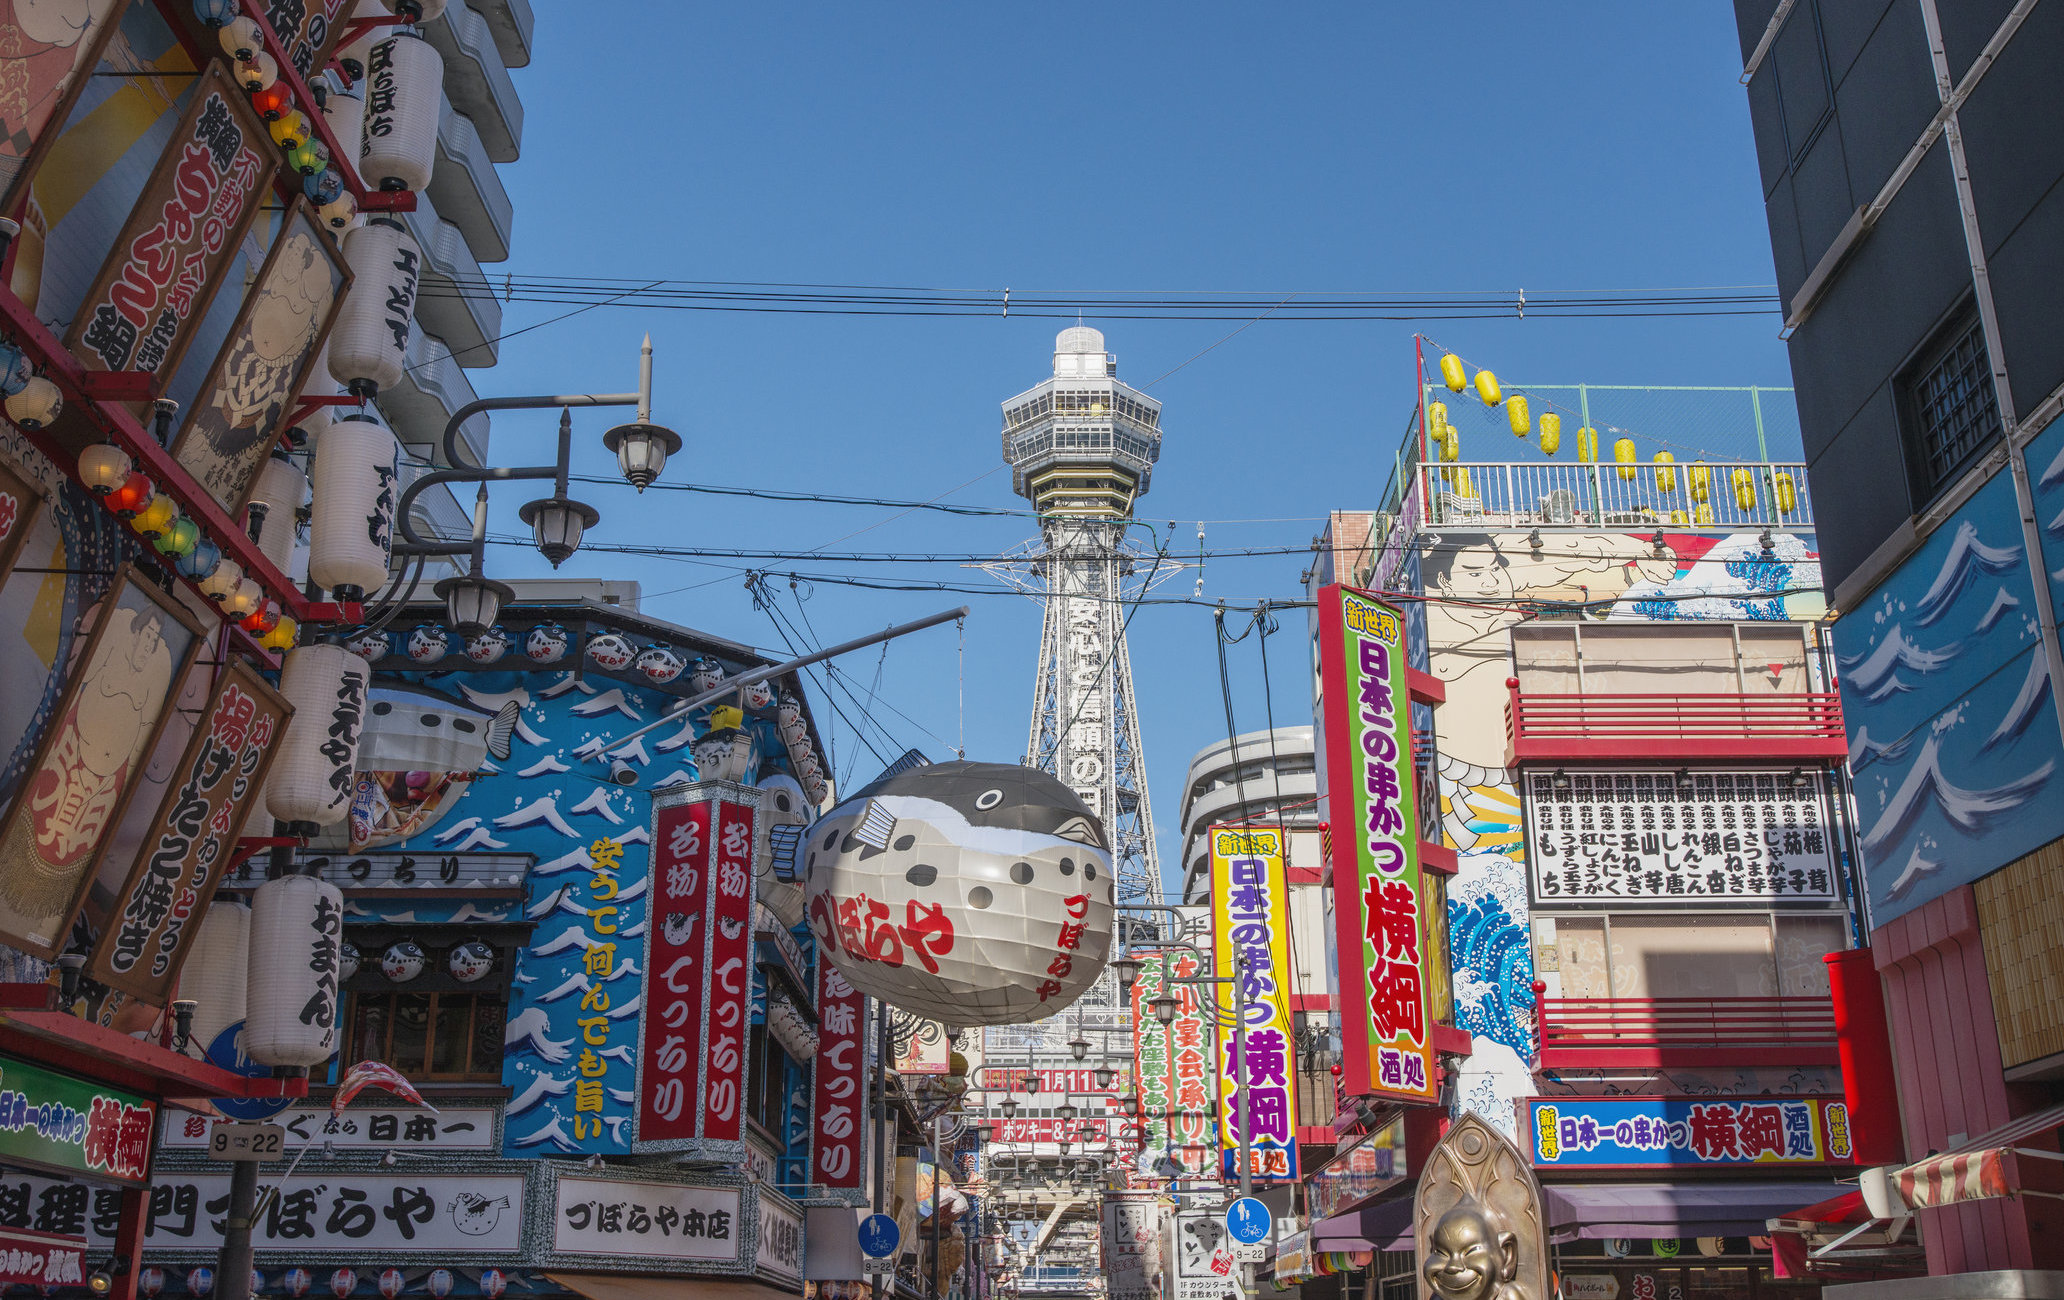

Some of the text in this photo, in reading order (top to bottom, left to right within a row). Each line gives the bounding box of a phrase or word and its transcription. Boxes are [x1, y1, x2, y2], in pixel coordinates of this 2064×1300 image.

[1345, 598, 1397, 645] 新世界
[112, 684, 257, 973] 揚げたこ焼き
[666, 821, 699, 898] 名物
[720, 822, 749, 898] 名物
[1217, 834, 1277, 857] 新世界
[1357, 639, 1426, 1045] 日本一の串かつ 横綱
[1539, 832, 1560, 895] もち
[1560, 832, 1583, 895] うずら玉子
[1579, 832, 1603, 895] 紅しょうが
[1600, 832, 1622, 895] にんにく
[1621, 832, 1644, 895] 玉ねぎ
[1641, 832, 1664, 895] 山芋
[1661, 832, 1685, 895] しし唐
[1681, 832, 1706, 895] れんこん
[1701, 832, 1726, 895] 銀杏
[1723, 832, 1746, 895] 白ねぎ
[1743, 832, 1767, 895] さつま芋
[1763, 832, 1788, 895] じゃが芋
[1783, 832, 1807, 895] 茄子
[1803, 832, 1827, 895] 椎茸
[811, 890, 954, 975] づぼらや
[1036, 892, 1092, 1002] づぼらや
[574, 836, 624, 1140] 安うて何んでも旨い
[1225, 859, 1290, 1145] 日本一の串かつ 横綱
[1379, 1050, 1426, 1090] 酒処
[84, 1095, 152, 1178] 横綱
[1536, 1106, 1559, 1160] 新世界
[1559, 1104, 1785, 1160] 日本一の串かつ 横綱
[1783, 1104, 1814, 1159] 酒処
[1825, 1104, 1852, 1157] 新世界
[1234, 1148, 1289, 1177] 酒処
[565, 1201, 732, 1240] づぼらや本店
